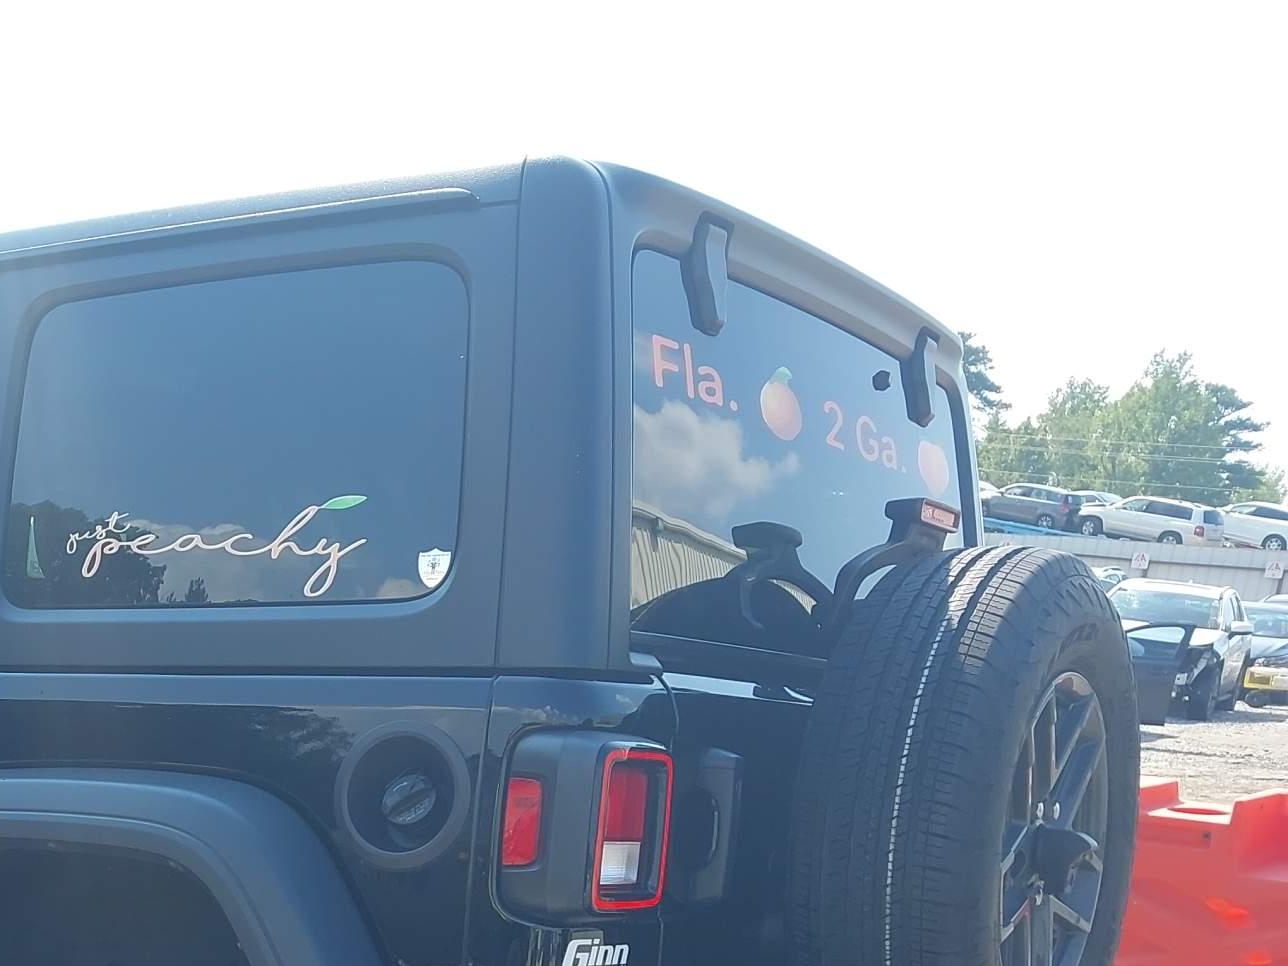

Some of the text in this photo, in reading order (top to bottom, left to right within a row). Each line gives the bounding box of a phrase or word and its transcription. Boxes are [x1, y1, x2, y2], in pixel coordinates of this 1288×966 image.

[651, 334, 739, 412] Fla.
[823, 400, 907, 474] 2 Ga.
[66, 511, 131, 554] just
[81, 505, 368, 598] peachy
